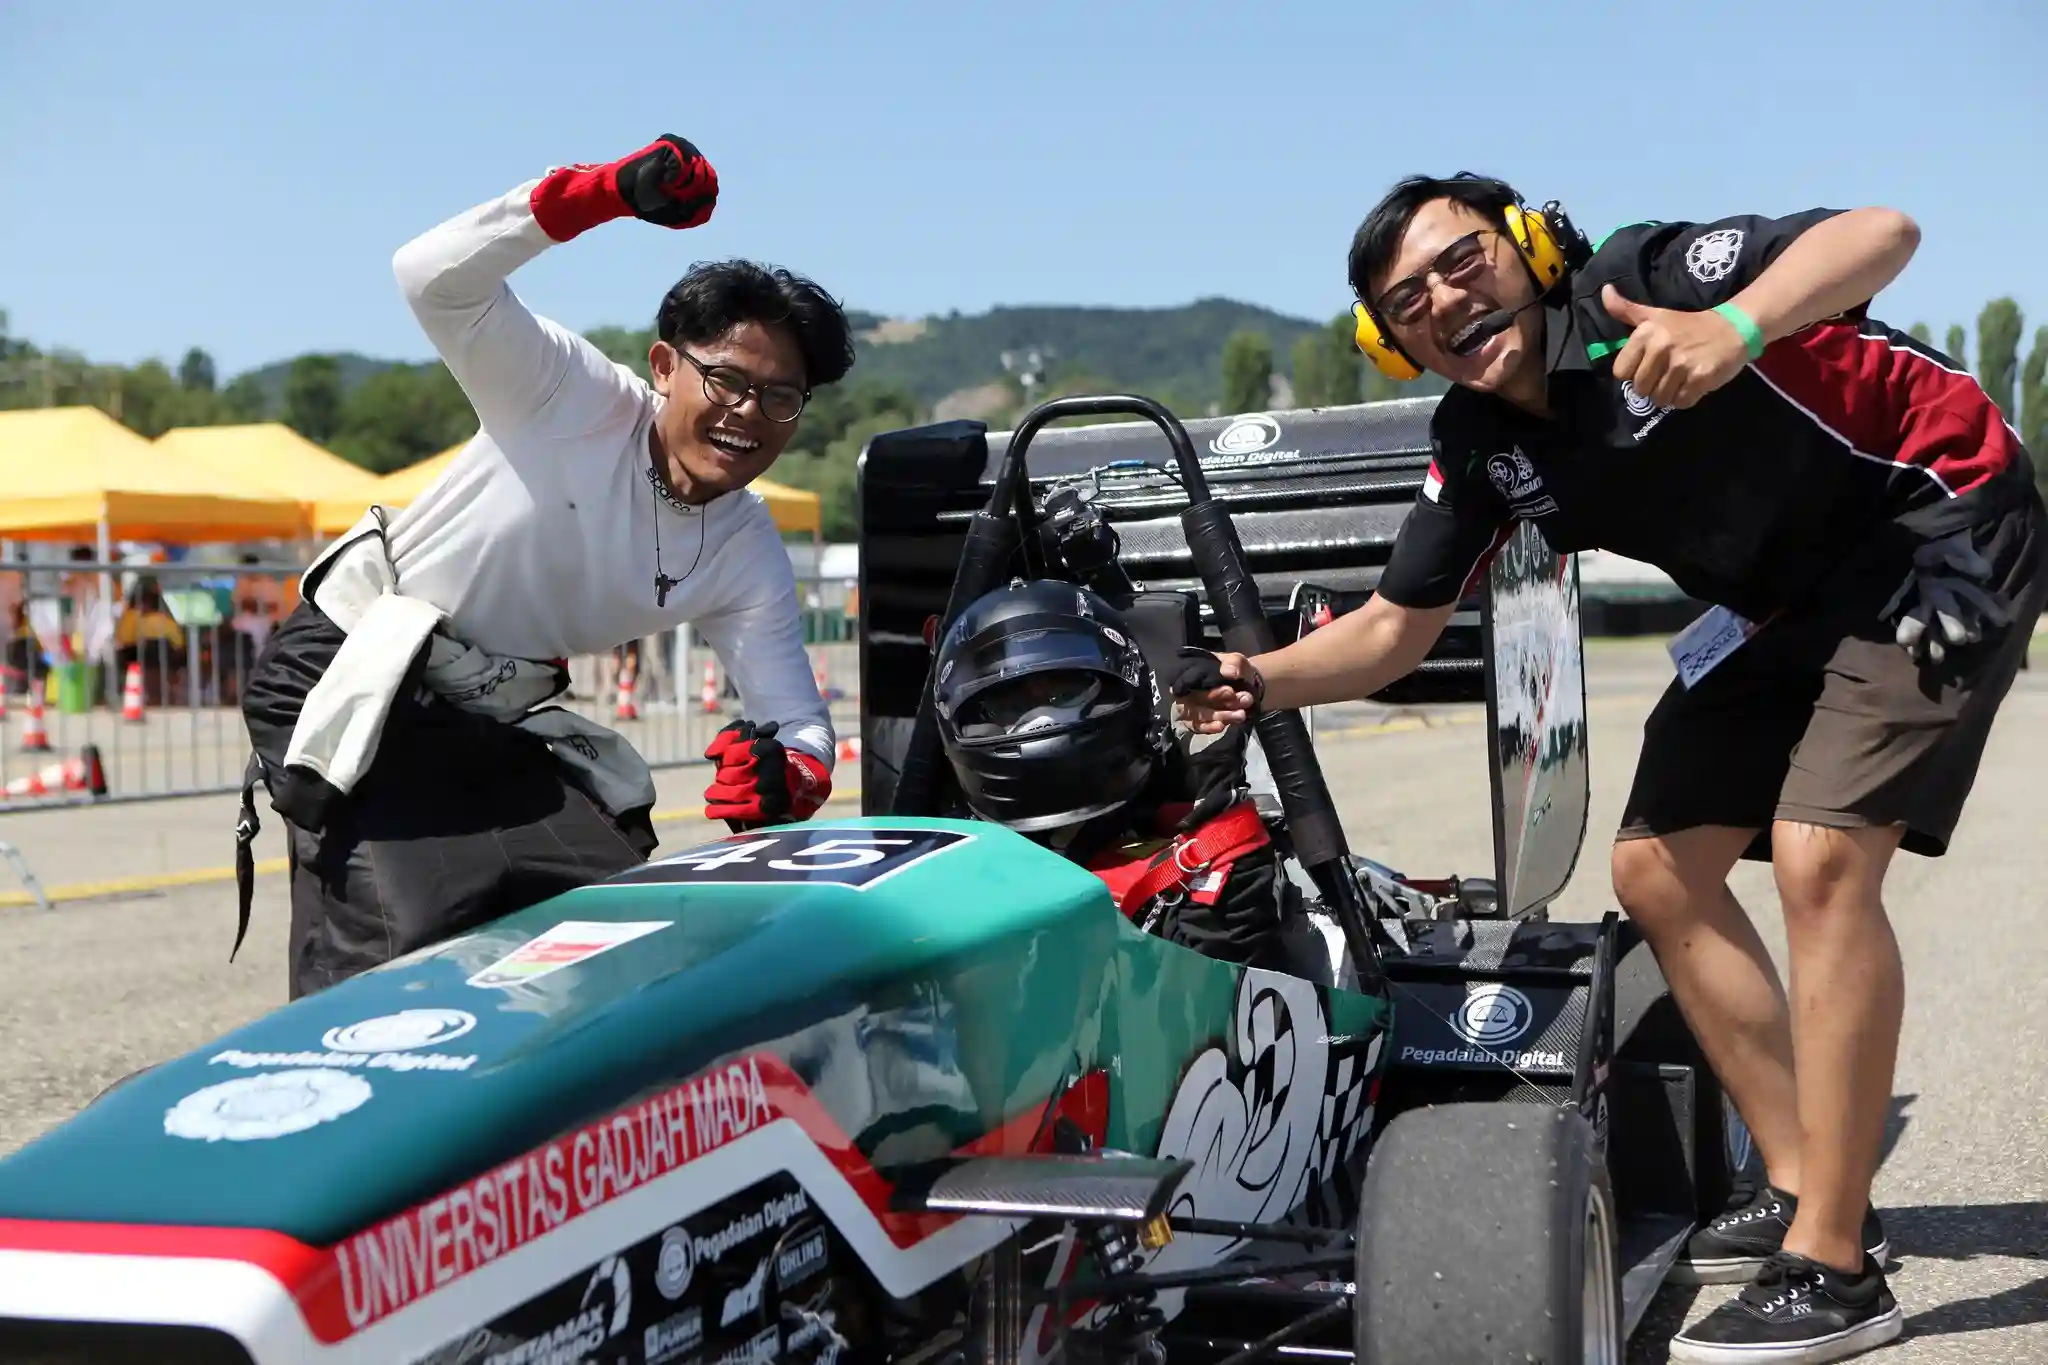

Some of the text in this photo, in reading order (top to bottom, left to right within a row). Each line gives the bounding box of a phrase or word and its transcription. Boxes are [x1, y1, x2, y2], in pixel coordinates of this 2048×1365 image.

[1247, 449, 1300, 465] Digital
[646, 838, 912, 871] 45
[1401, 1046, 1564, 1068] Pegadaian Digital
[335, 1056, 773, 1328] UNIVERSITAS GADJAH MADA
[694, 1188, 808, 1265] Pegadaian Digital
